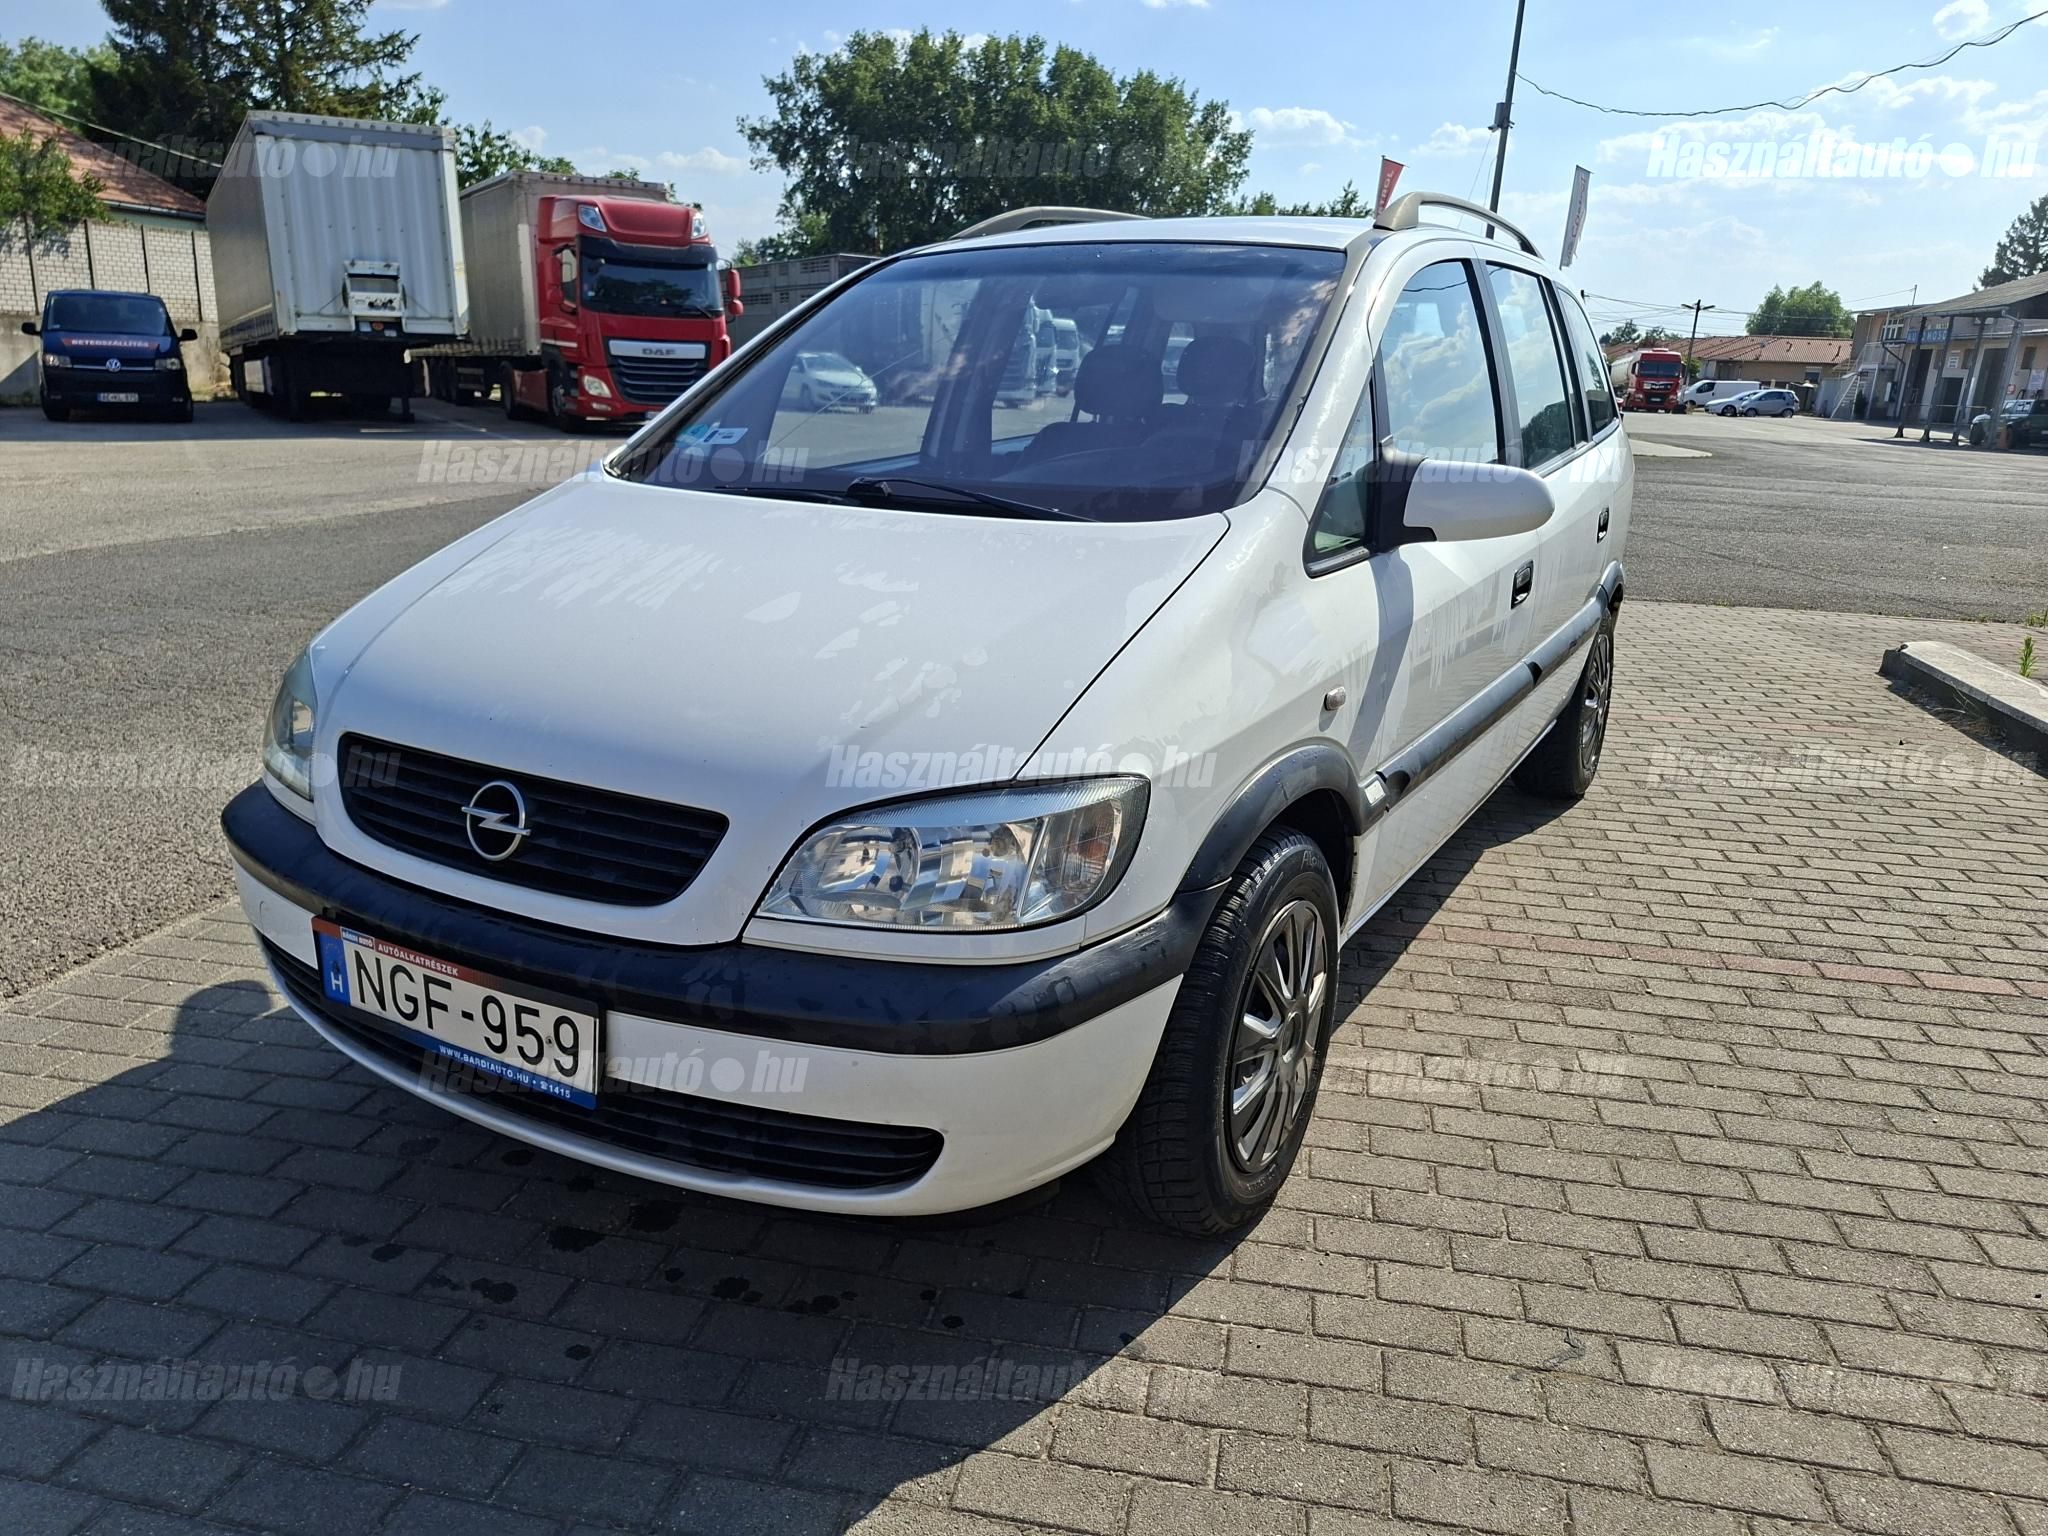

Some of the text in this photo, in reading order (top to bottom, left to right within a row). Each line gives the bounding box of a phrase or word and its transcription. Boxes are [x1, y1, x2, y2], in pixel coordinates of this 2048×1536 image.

[642, 348, 676, 356] DAF
[378, 944, 459, 976] AUTÓALKATRÉSZEK
[330, 971, 344, 994] H
[354, 950, 580, 1078] NGF-959
[438, 1045, 529, 1085] WWW.BARDIAUTO.HU
